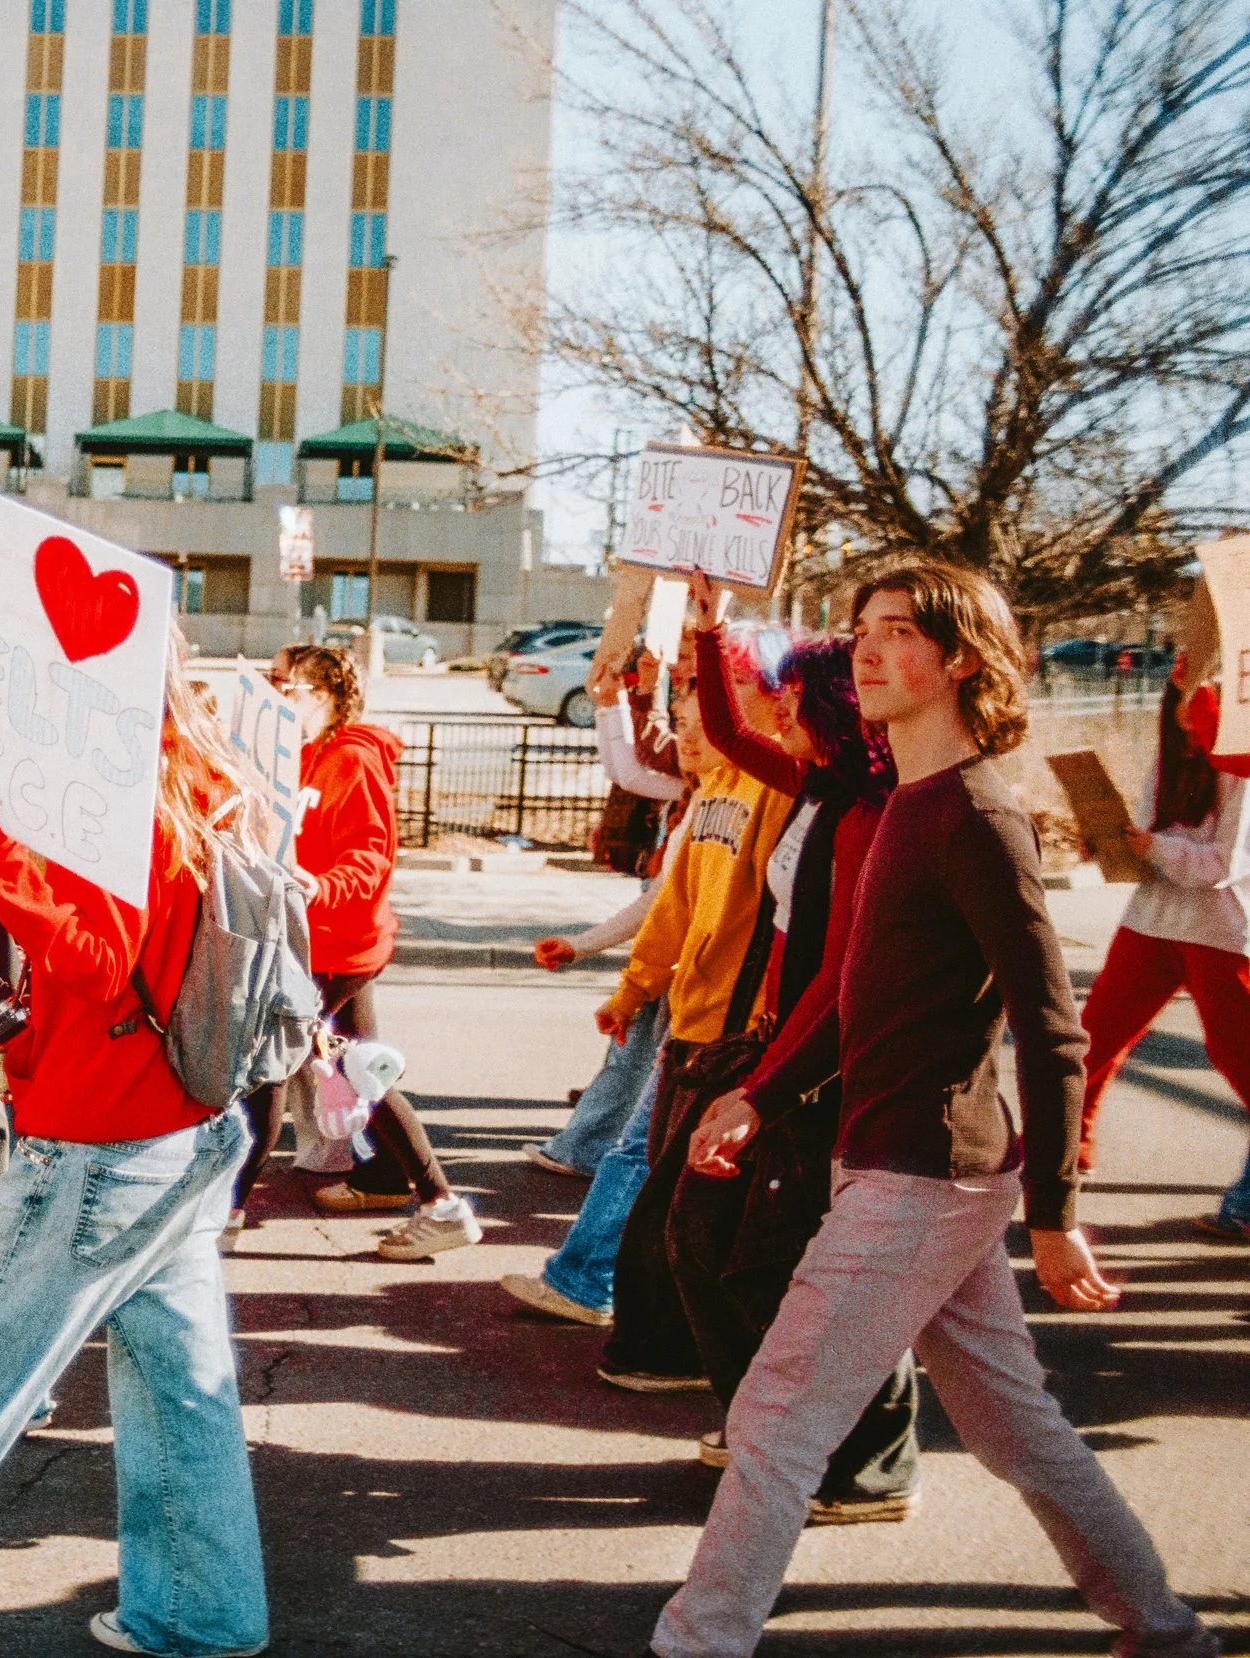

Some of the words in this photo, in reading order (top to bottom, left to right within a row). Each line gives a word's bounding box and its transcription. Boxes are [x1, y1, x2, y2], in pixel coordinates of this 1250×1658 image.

[638, 460, 682, 501] BITE
[720, 466, 783, 513] BACK
[723, 534, 770, 580] KILLS
[230, 674, 296, 798] ICE
